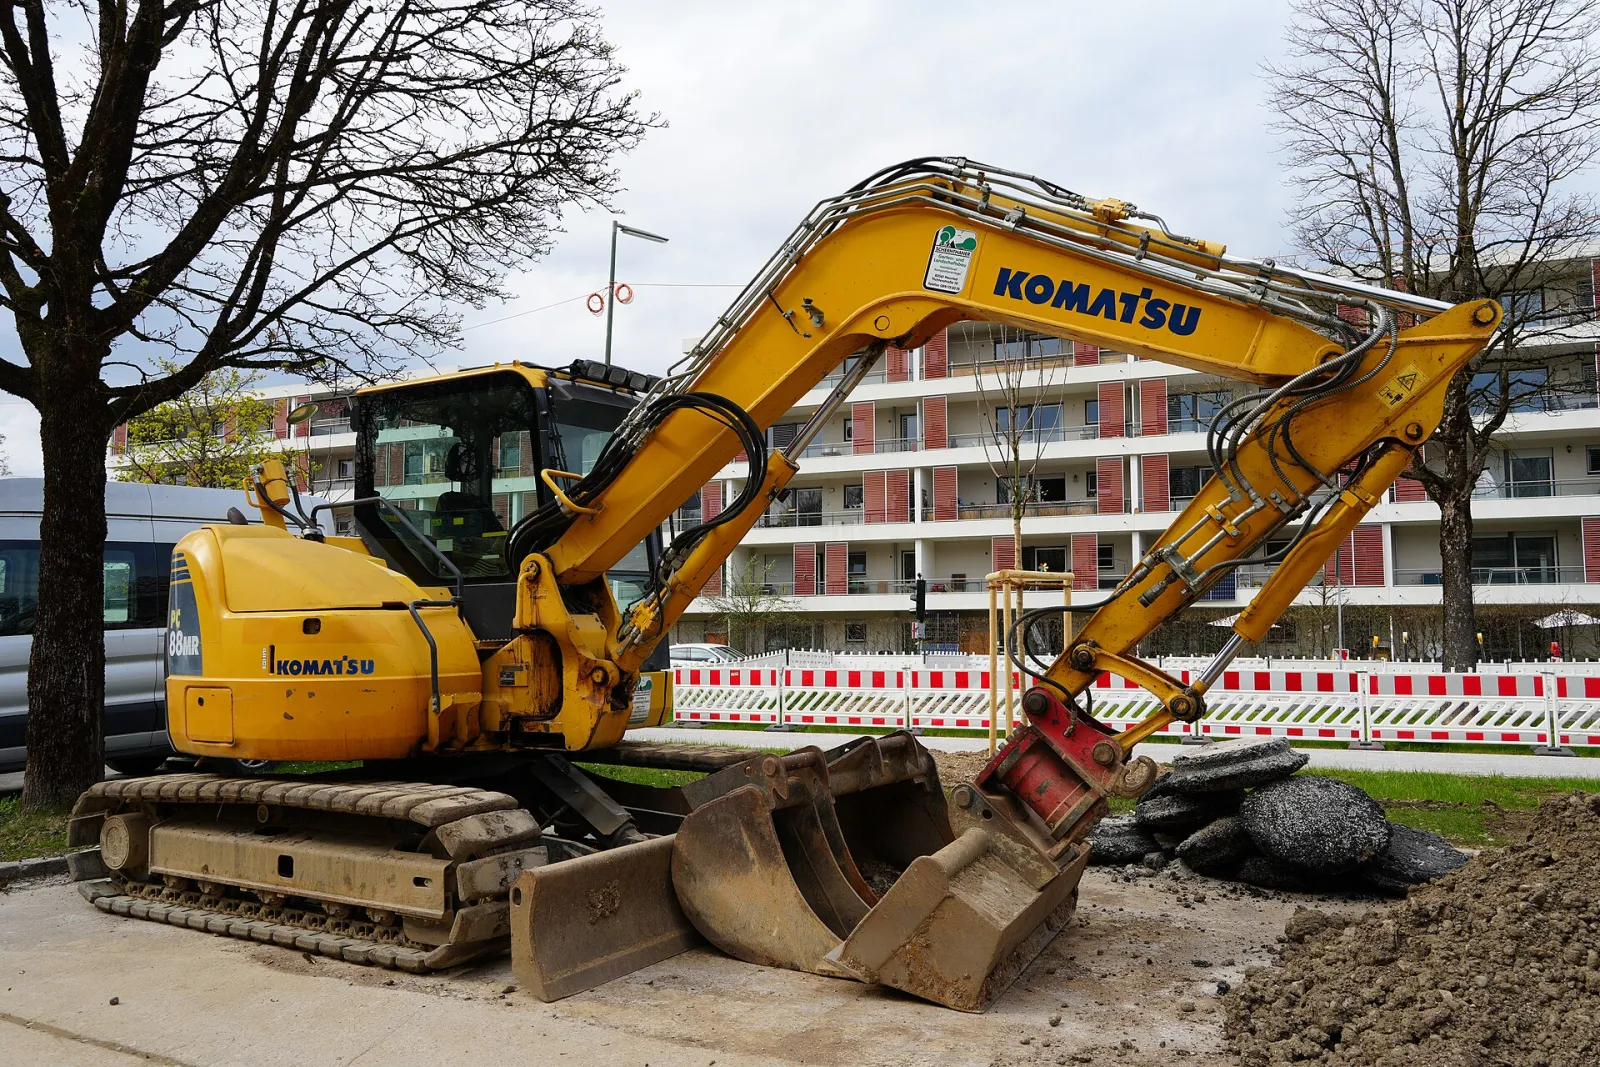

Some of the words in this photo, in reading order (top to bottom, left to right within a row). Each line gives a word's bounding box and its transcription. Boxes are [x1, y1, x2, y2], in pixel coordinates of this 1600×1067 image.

[993, 267, 1202, 336] KOMATSU
[170, 608, 182, 629] PC
[169, 630, 200, 657] 88MR
[277, 655, 375, 676] KOMATSU
